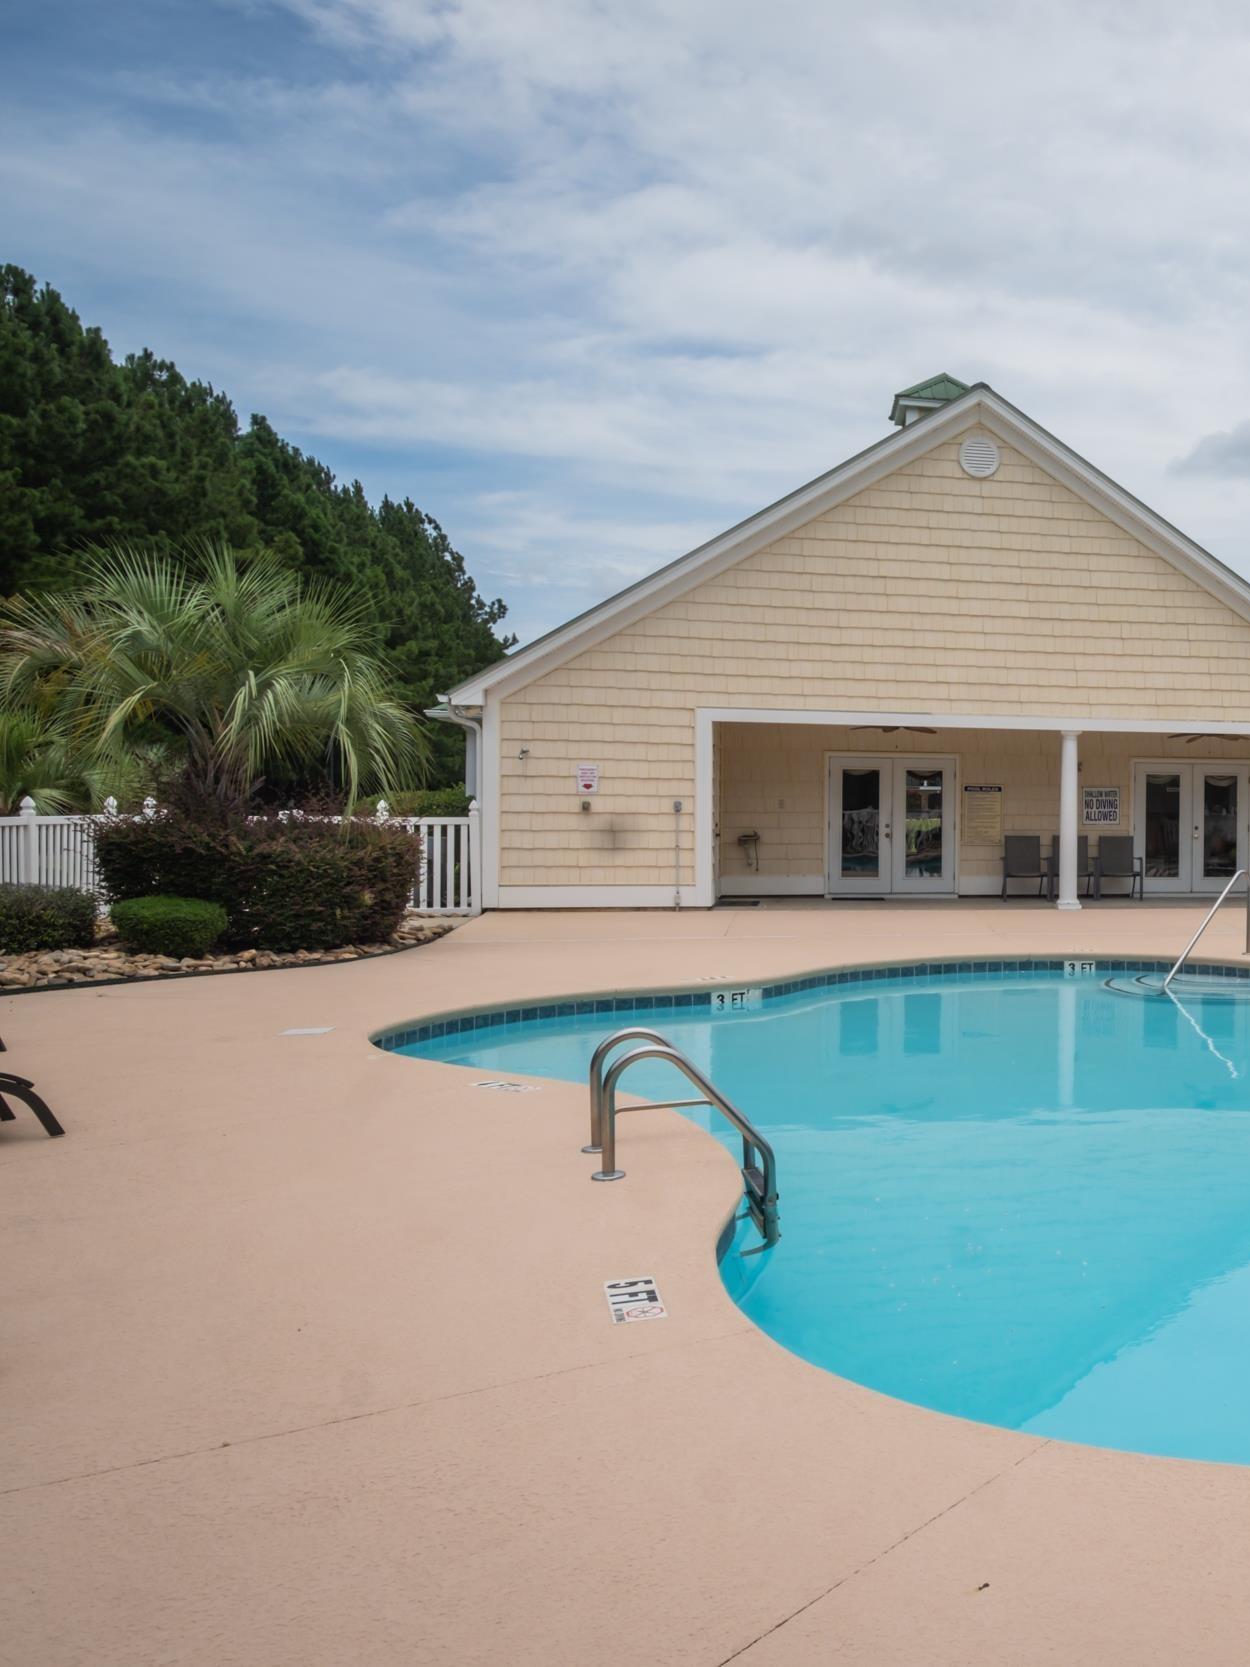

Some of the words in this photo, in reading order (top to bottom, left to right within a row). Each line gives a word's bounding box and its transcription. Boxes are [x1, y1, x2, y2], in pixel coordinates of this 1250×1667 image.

[1085, 798, 1094, 810] NO
[1095, 798, 1118, 810] DIVING
[1085, 810, 1118, 822] ALLOWED
[1081, 962, 1094, 973] FT
[716, 994, 725, 1005] 3
[731, 991, 746, 1004] FT
[609, 1289, 659, 1305] FT
